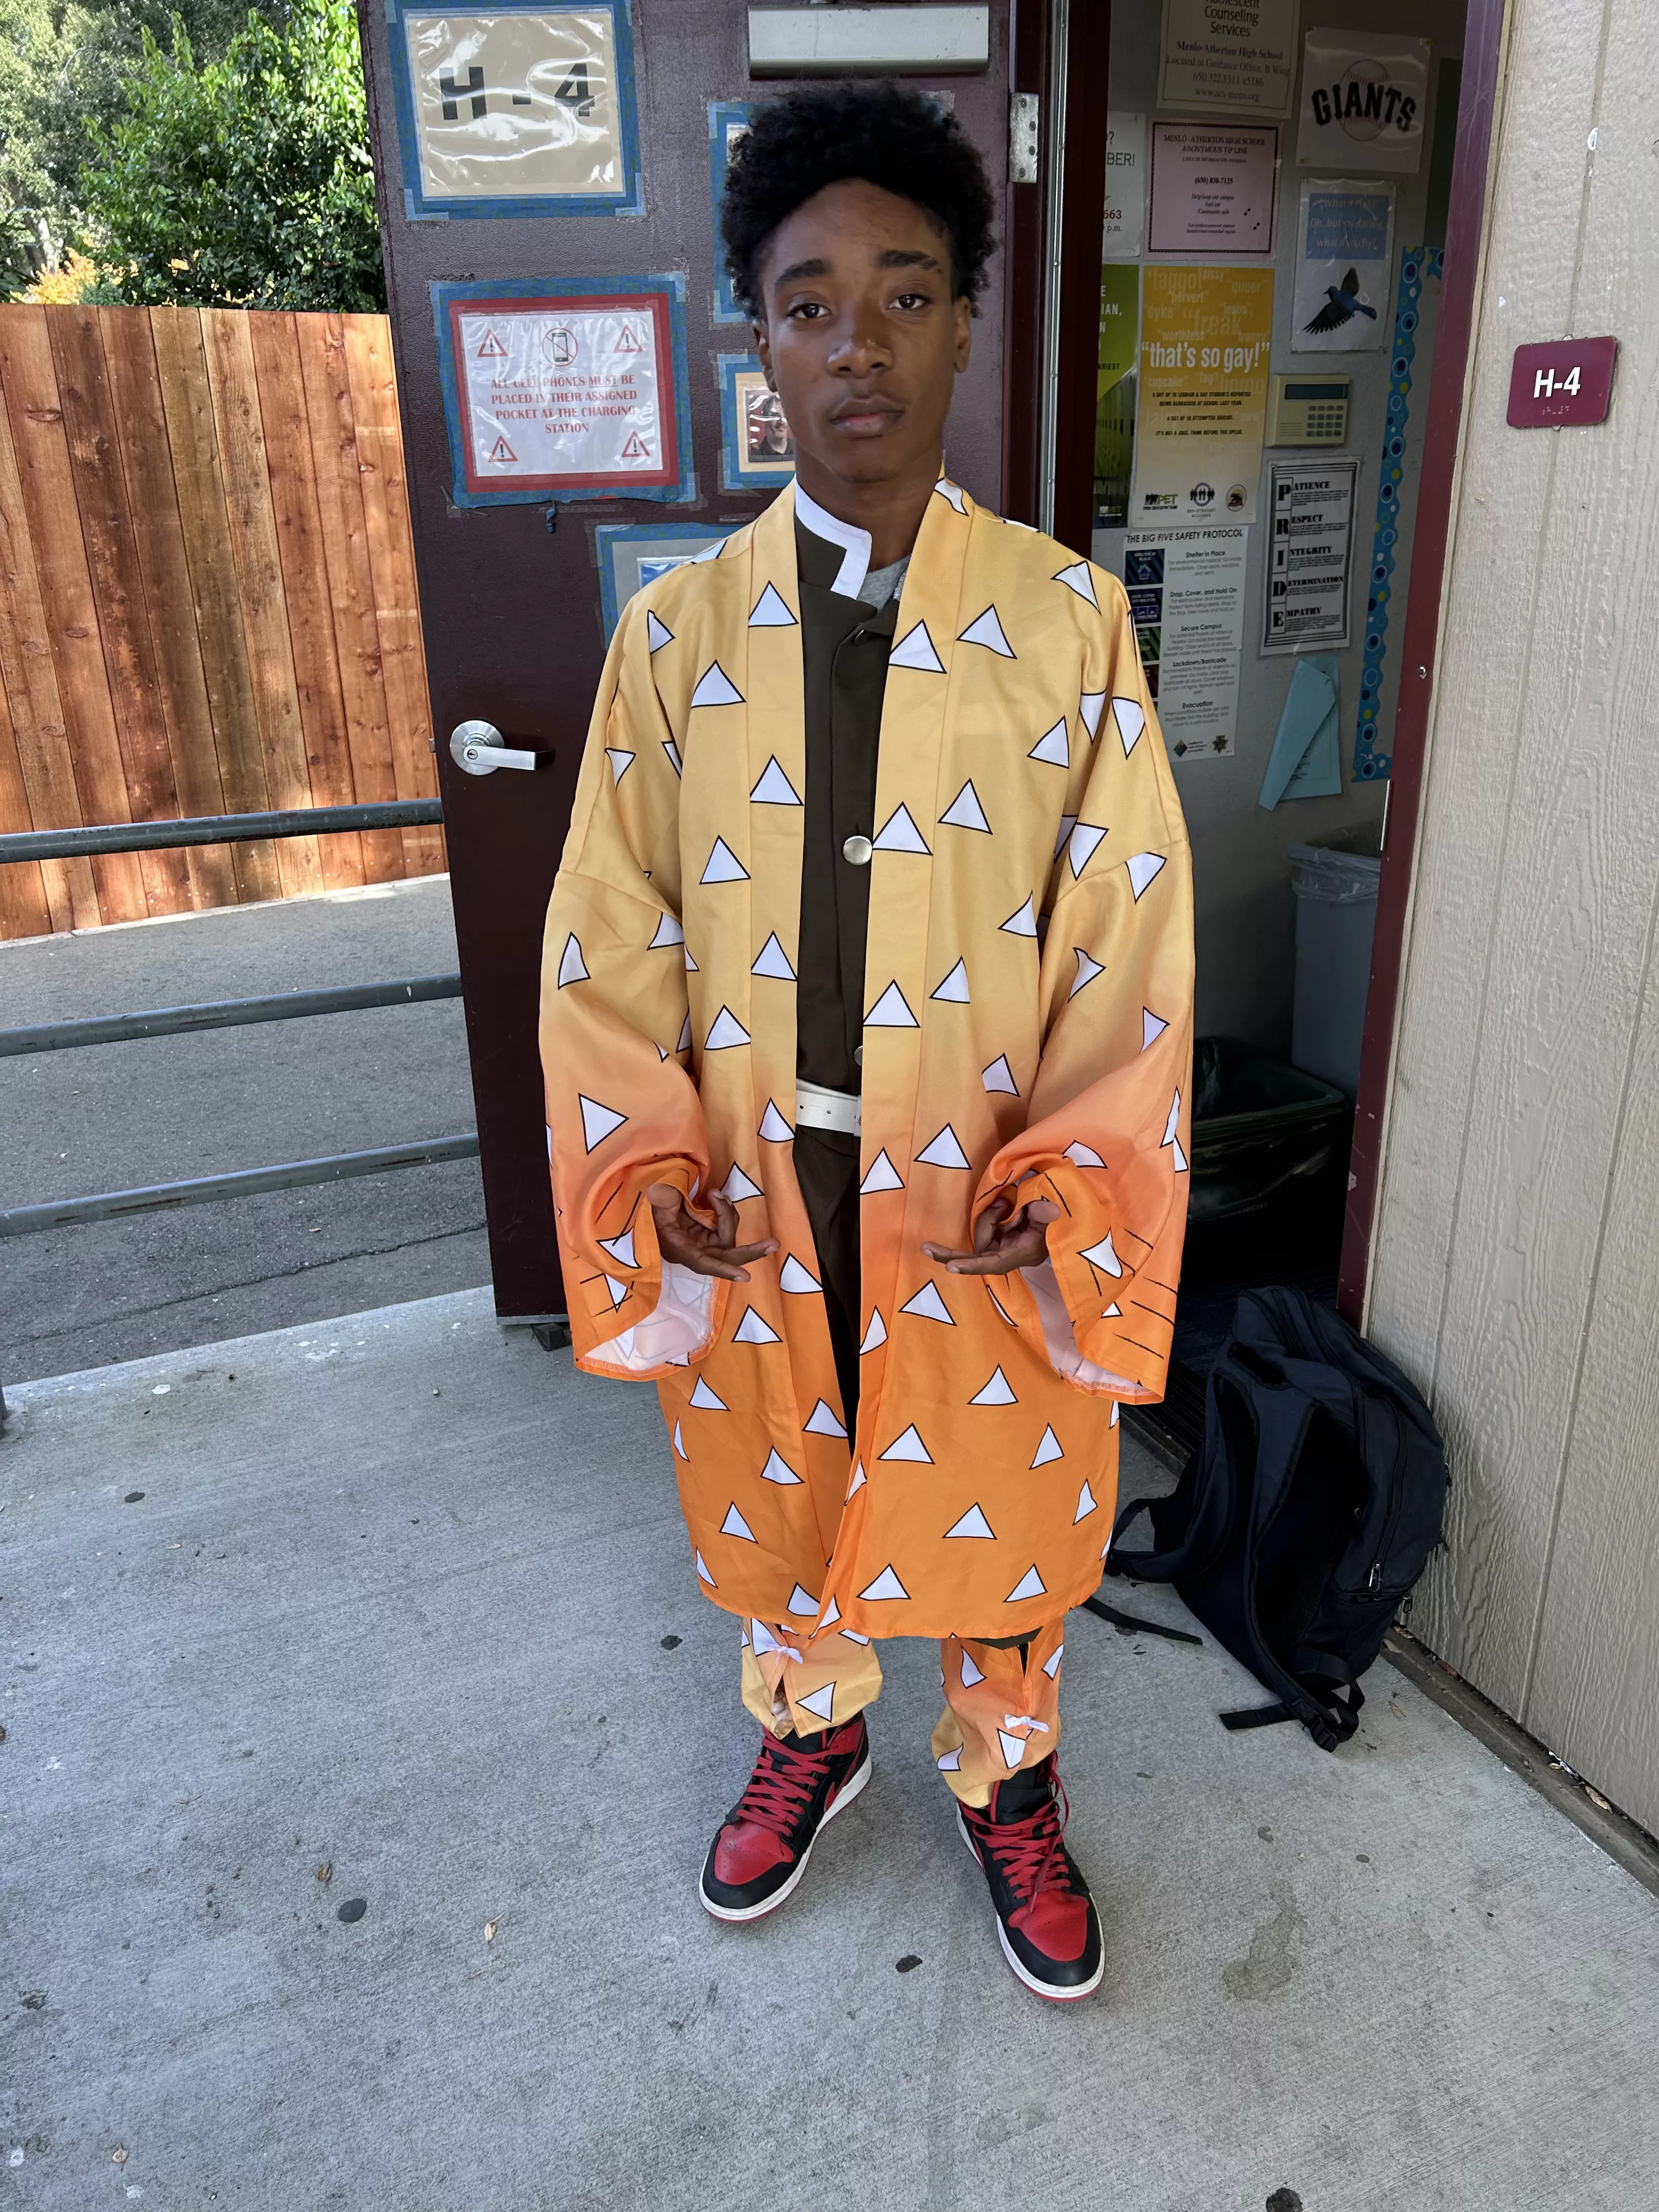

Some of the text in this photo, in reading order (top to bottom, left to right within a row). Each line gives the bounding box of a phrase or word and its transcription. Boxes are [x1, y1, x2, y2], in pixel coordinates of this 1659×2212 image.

[1205, 0, 1260, 8] dolescent
[1204, 5, 1259, 27] Counseling
[1210, 21, 1251, 37] Services
[1177, 40, 1283, 60] Menlo-Atherton High School
[1166, 54, 1195, 66] Located
[1197, 58, 1204, 66] in
[1206, 58, 1238, 70] Guidance
[1273, 65, 1290, 78] Wing
[439, 66, 488, 120] H
[554, 63, 595, 117] 4
[1311, 82, 1417, 133] GIANTS
[1164, 134, 1187, 143] MENLO
[1225, 137, 1241, 145] HIGH
[1242, 138, 1266, 146] SCHOOL
[1234, 146, 1248, 155] LINE
[1194, 177, 1209, 185] (650)
[1107, 225, 1122, 234] p.m.
[1311, 218, 1324, 228] Oh,
[1327, 218, 1340, 228] but
[1317, 238, 1337, 247] what
[1201, 347, 1220, 368] so
[491, 374, 635, 389] ALL CELL PHONES MUST BE
[1533, 366, 1581, 398] H-4
[491, 390, 637, 404] PLACED IN THEIR ASSIGNED
[495, 405, 636, 420] POCKET AT THE CHARGING
[545, 422, 589, 434] STATION
[1277, 484, 1291, 501] P
[1294, 481, 1331, 490] ATIENCE
[1158, 494, 1179, 505] PET
[1276, 518, 1289, 535] R
[1292, 514, 1323, 524] ESPECT
[1127, 529, 1243, 544] THE BIG FIVE SAFETY PROTOCOL
[1290, 545, 1333, 556] NTEGRITY
[1288, 575, 1344, 586] ETERMINATION
[1286, 607, 1322, 617] MPATHY
[1182, 701, 1214, 709] Evacuation
